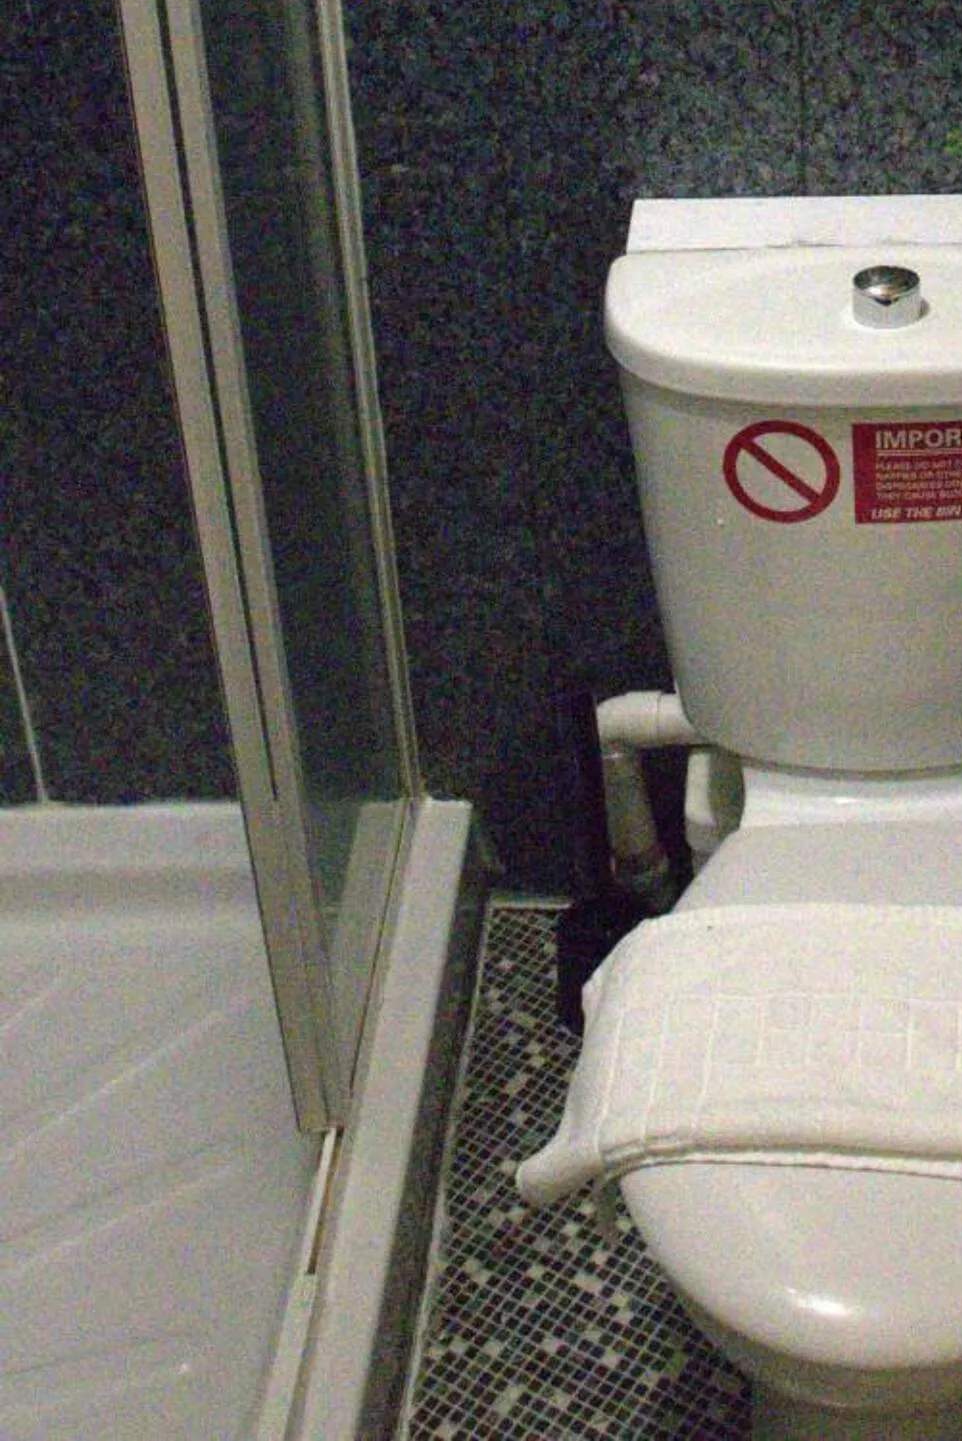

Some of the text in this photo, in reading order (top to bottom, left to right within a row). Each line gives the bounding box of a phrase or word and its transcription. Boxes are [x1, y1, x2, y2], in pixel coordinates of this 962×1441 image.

[872, 506, 901, 520] USE
[905, 505, 932, 519] THE
[935, 504, 962, 517] BIN
